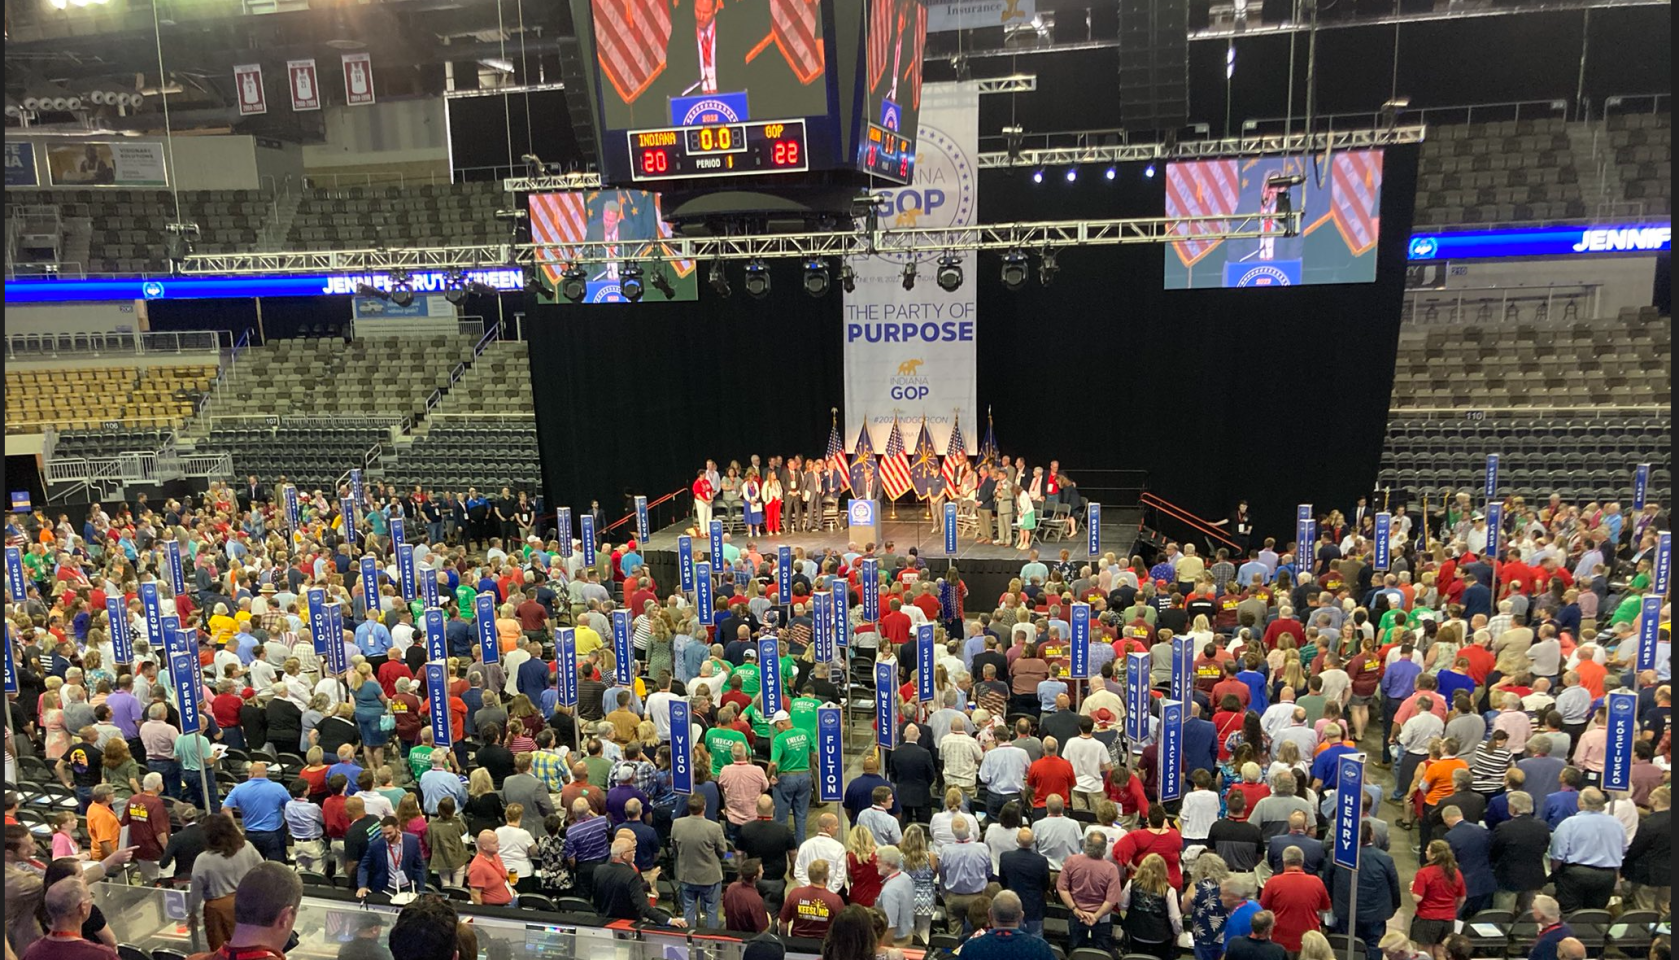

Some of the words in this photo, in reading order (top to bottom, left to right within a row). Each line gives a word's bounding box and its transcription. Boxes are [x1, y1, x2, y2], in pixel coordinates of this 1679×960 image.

[946, 3, 1002, 16] Insurance
[638, 132, 676, 148] INDIANA
[764, 124, 784, 139] GOP
[644, 150, 668, 173] 20
[696, 158, 721, 169] PERIOD
[774, 140, 798, 165] 22
[877, 189, 946, 218] GOP
[846, 304, 879, 320] THE
[884, 303, 944, 320] PARTY
[949, 302, 974, 318] OF
[848, 321, 973, 343] PURPOSE
[890, 377, 929, 385] INDIANA
[890, 386, 929, 400] GOP
[1466, 412, 1483, 420] 110
[12, 563, 22, 597] JOHNSON
[1658, 550, 1668, 591] BENTON
[112, 617, 122, 658] DECATUR
[124, 616, 132, 656] DECATUR
[149, 604, 158, 637] BROWN
[315, 613, 324, 641] OHIO
[484, 621, 493, 650] CLAY
[326, 625, 334, 668] FAYETTE
[336, 624, 344, 667] FAYETTE
[618, 630, 627, 682] SULLIVAN
[1644, 619, 1653, 666] ELKHART
[567, 652, 575, 698] WARRICK
[766, 658, 776, 714] CRAWFORD
[182, 682, 194, 723] PERRY
[434, 688, 444, 738] SPENCER
[880, 690, 889, 735] WELLS
[676, 735, 685, 774] VIGO
[713, 737, 734, 746] DIEGO
[786, 735, 806, 746] DIEGO
[1611, 720, 1625, 785] KOSCIUSKO
[826, 735, 837, 794] FULTON
[1168, 730, 1176, 793] BLACKFORD
[1342, 794, 1354, 851] HENRY
